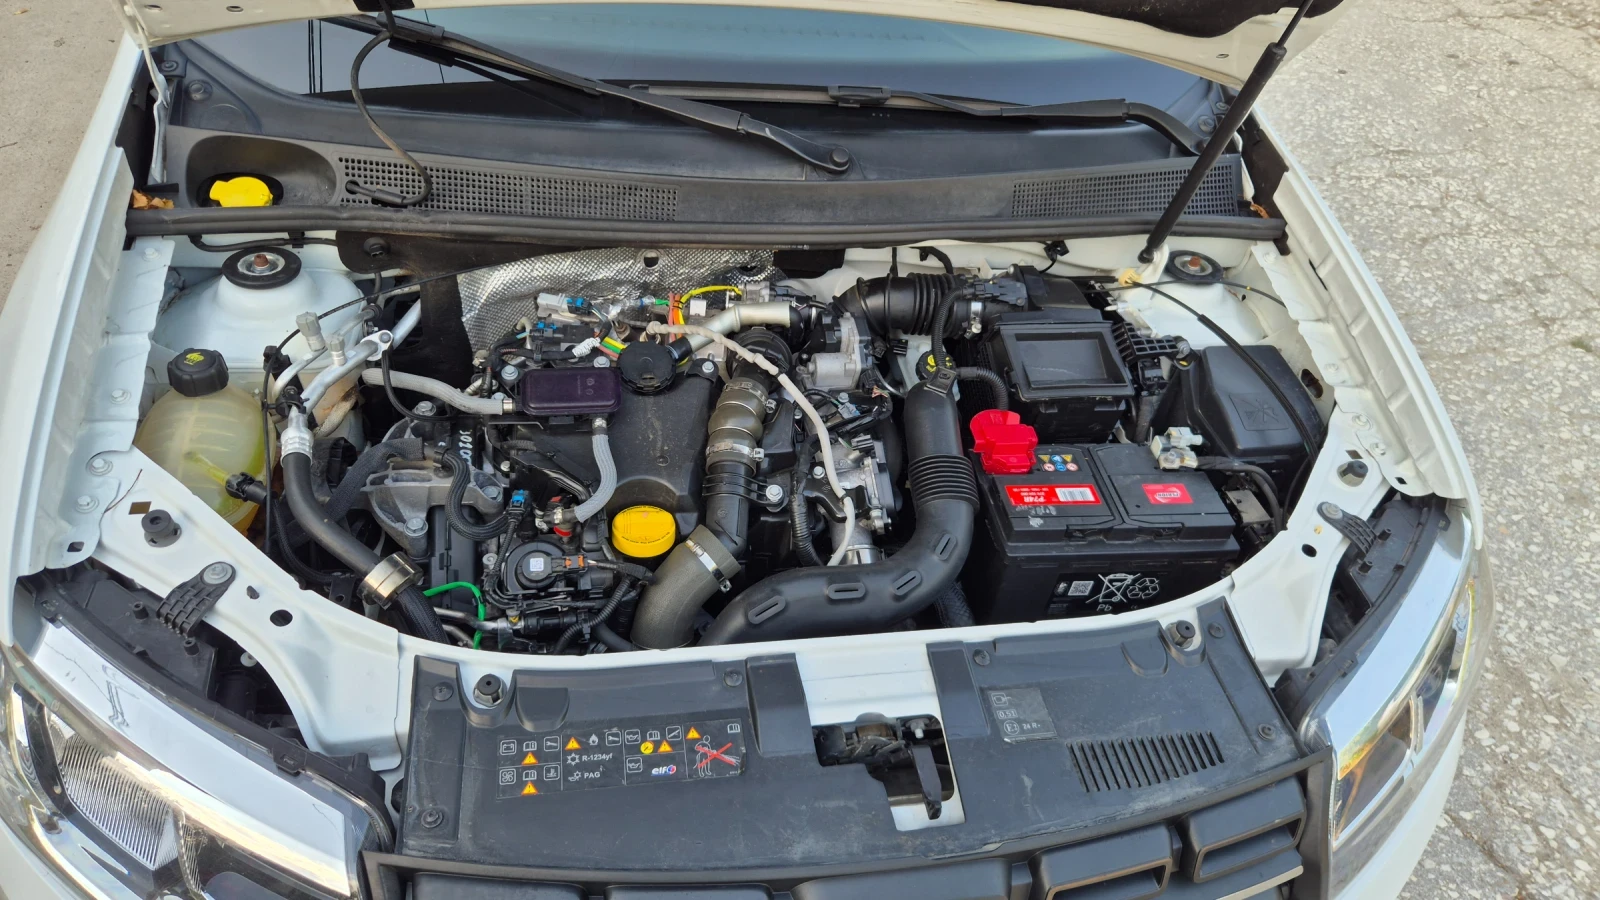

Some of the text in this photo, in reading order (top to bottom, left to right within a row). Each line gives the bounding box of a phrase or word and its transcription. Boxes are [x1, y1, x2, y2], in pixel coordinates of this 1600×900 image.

[1096, 604, 1112, 612] Pb
[582, 752, 613, 762] R-1234yf
[584, 771, 601, 779] PAG
[651, 765, 670, 776] elf
